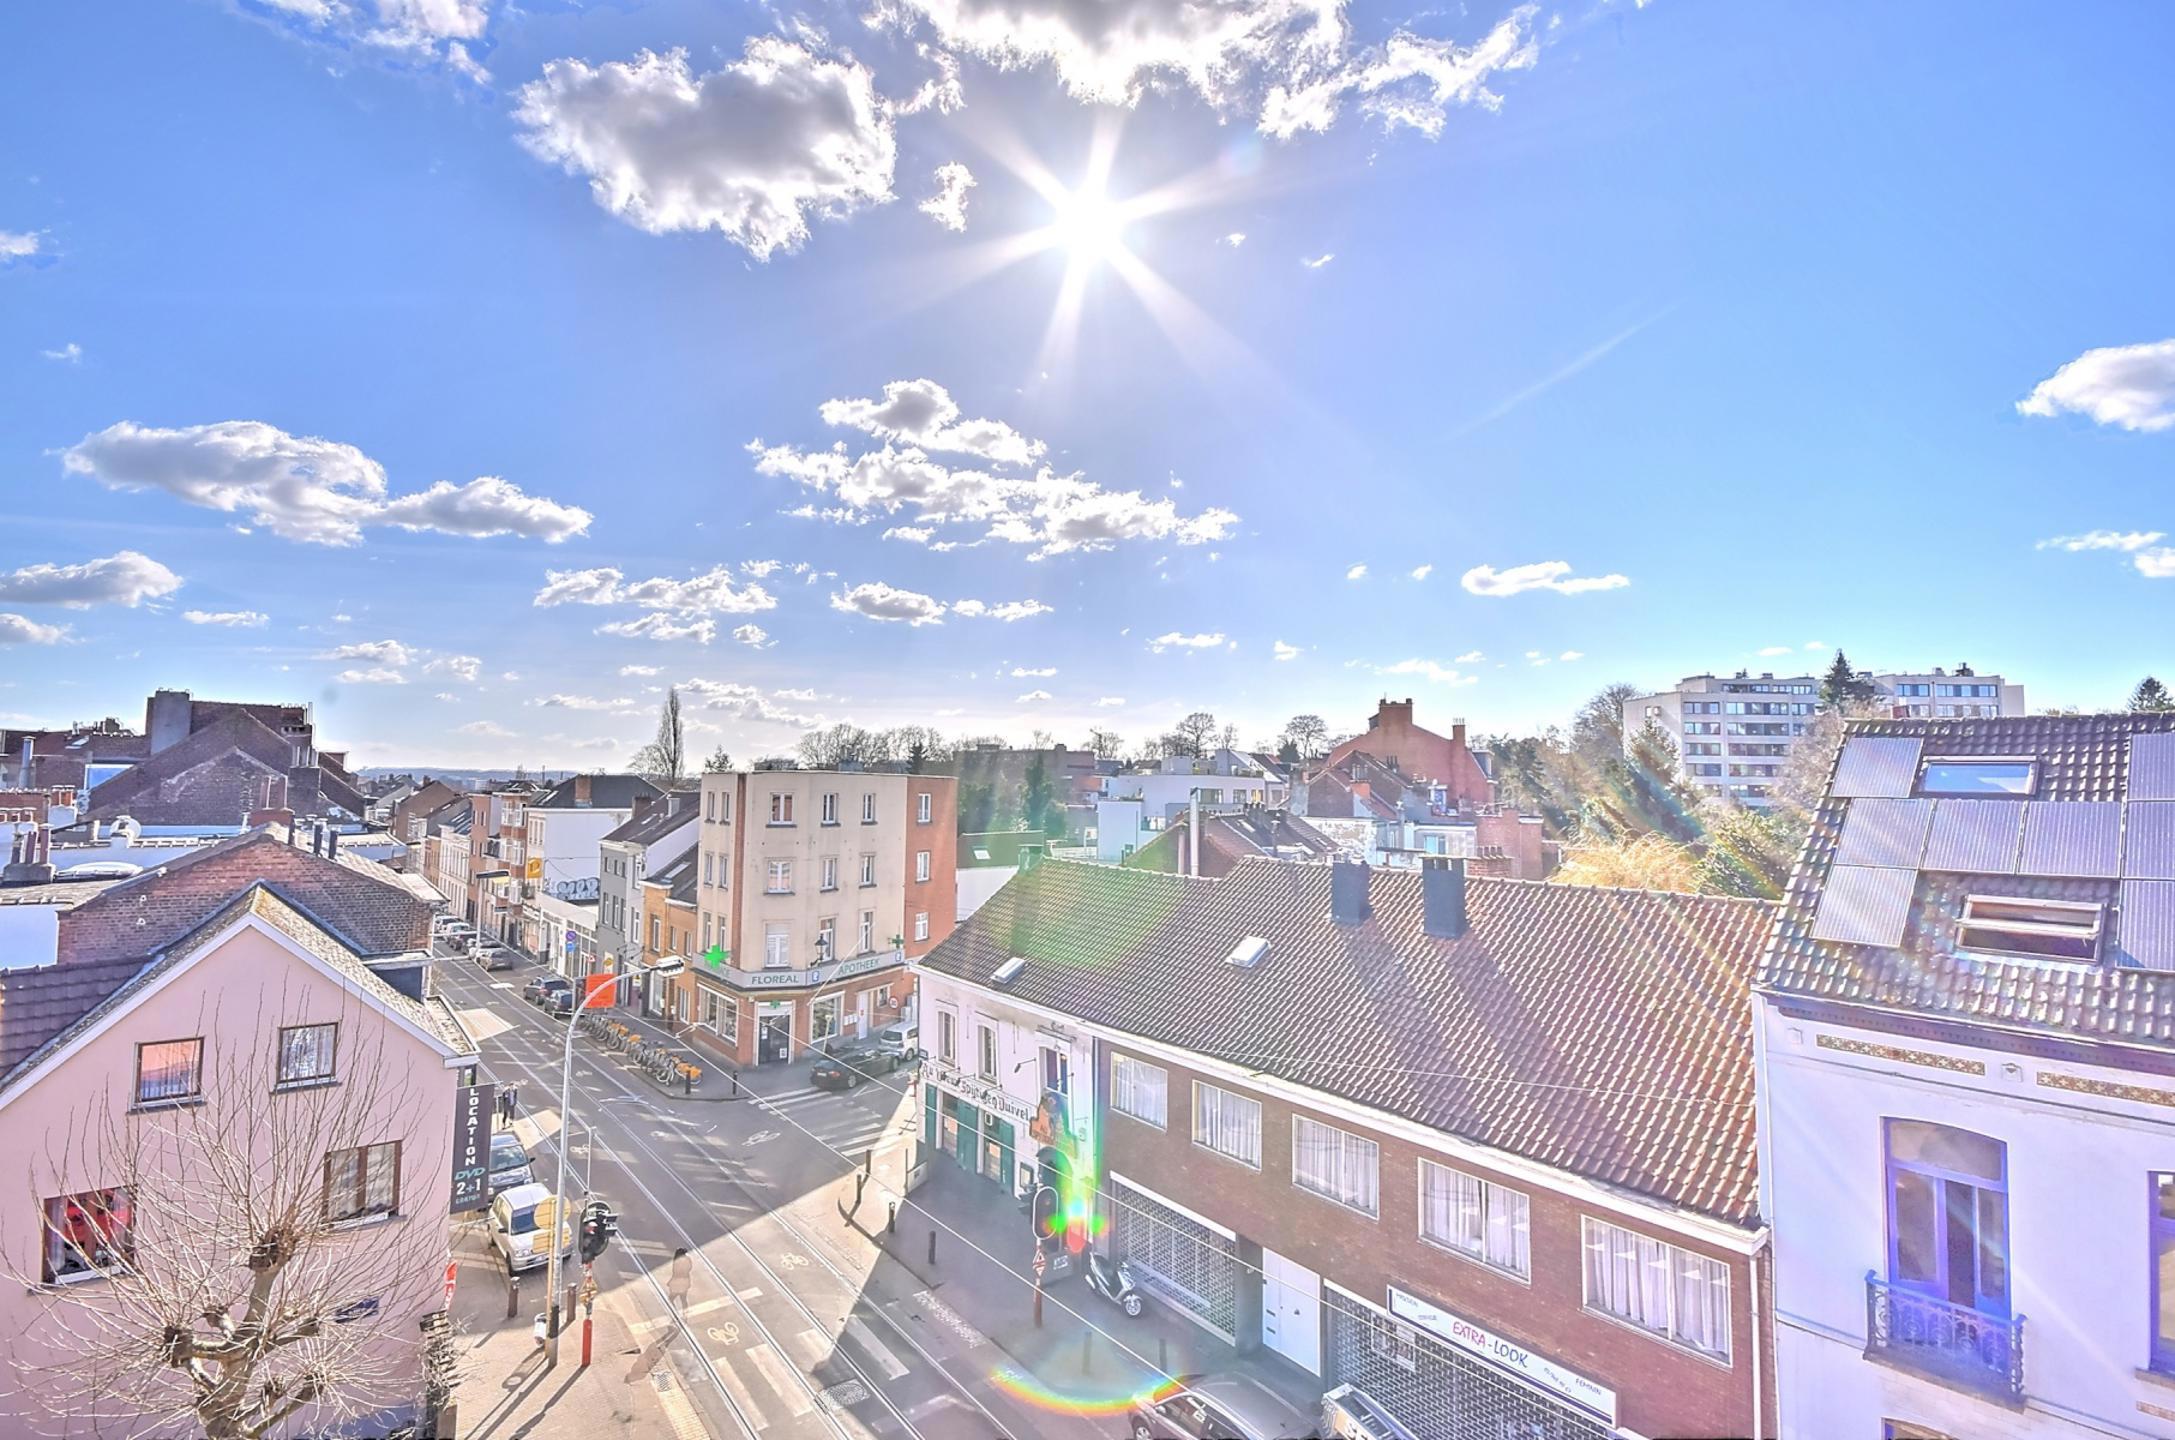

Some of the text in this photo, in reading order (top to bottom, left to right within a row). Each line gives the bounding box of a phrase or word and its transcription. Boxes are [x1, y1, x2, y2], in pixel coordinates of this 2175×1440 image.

[838, 959, 880, 976] APOTHEEK
[751, 975, 799, 985] FLOREAL
[464, 1087, 480, 1166] LOCATION
[454, 1167, 486, 1180] DVD
[456, 1178, 481, 1195] 2+1
